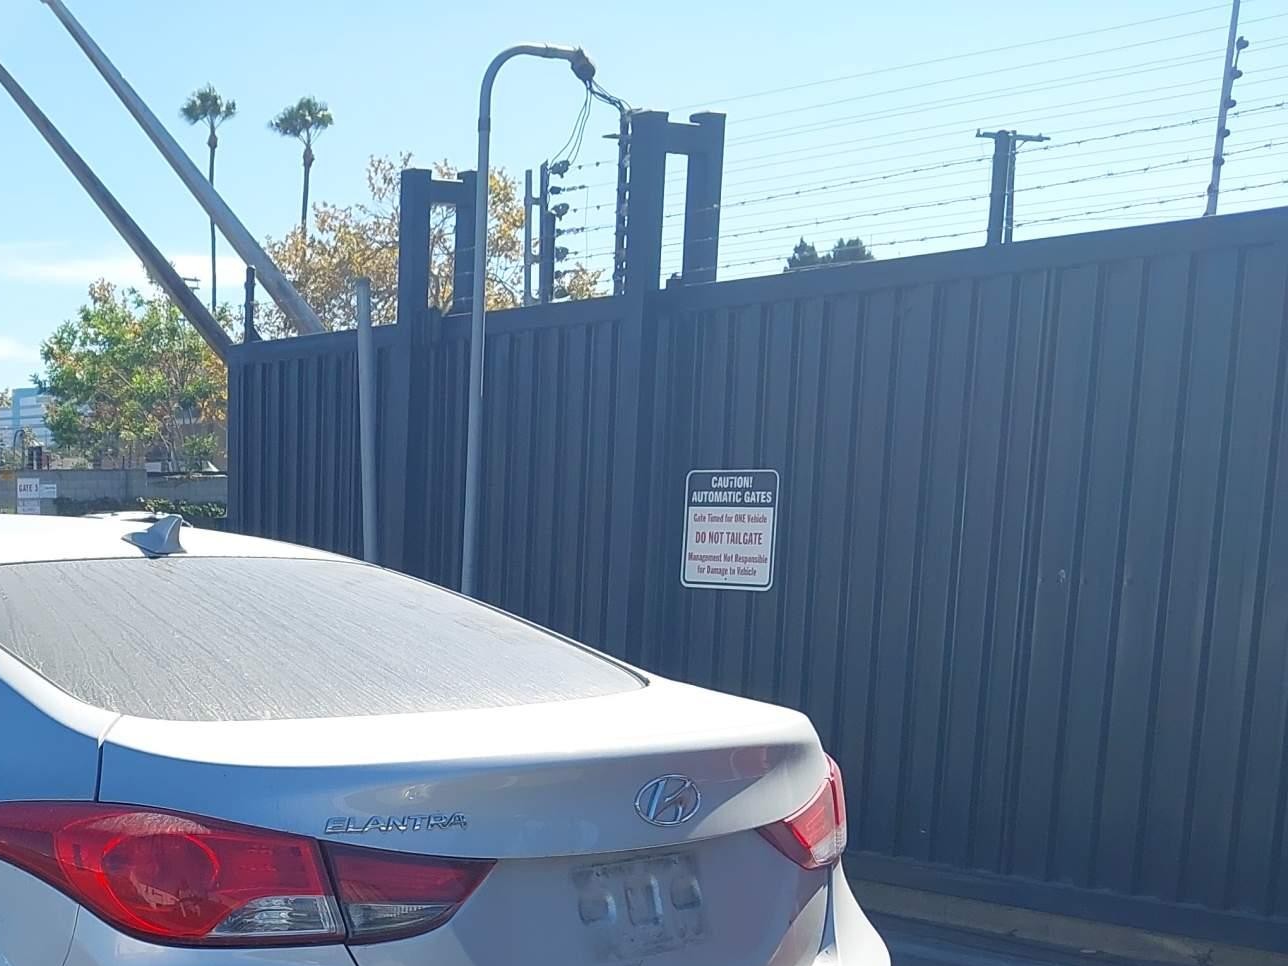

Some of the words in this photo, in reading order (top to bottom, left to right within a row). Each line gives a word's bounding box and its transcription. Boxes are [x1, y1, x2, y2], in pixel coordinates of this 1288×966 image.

[711, 476, 753, 488] CAUTION!
[691, 491, 742, 503] AUTOMATIC
[743, 491, 773, 503] GATES
[693, 513, 706, 523] Gate
[707, 513, 724, 523] Timed
[724, 513, 733, 523] for
[734, 514, 746, 523] ONE
[747, 514, 768, 524] Vehicle
[695, 531, 706, 543] DO
[708, 532, 724, 544] NOT
[725, 532, 763, 545] TAILGATE
[688, 552, 722, 563] Management
[723, 553, 733, 562] Not
[734, 554, 768, 564] Responsible
[697, 565, 705, 574] for
[706, 565, 728, 576] Damage
[729, 566, 736, 575] to
[736, 566, 757, 576] Vehicle
[324, 812, 468, 835] ELANTRA
